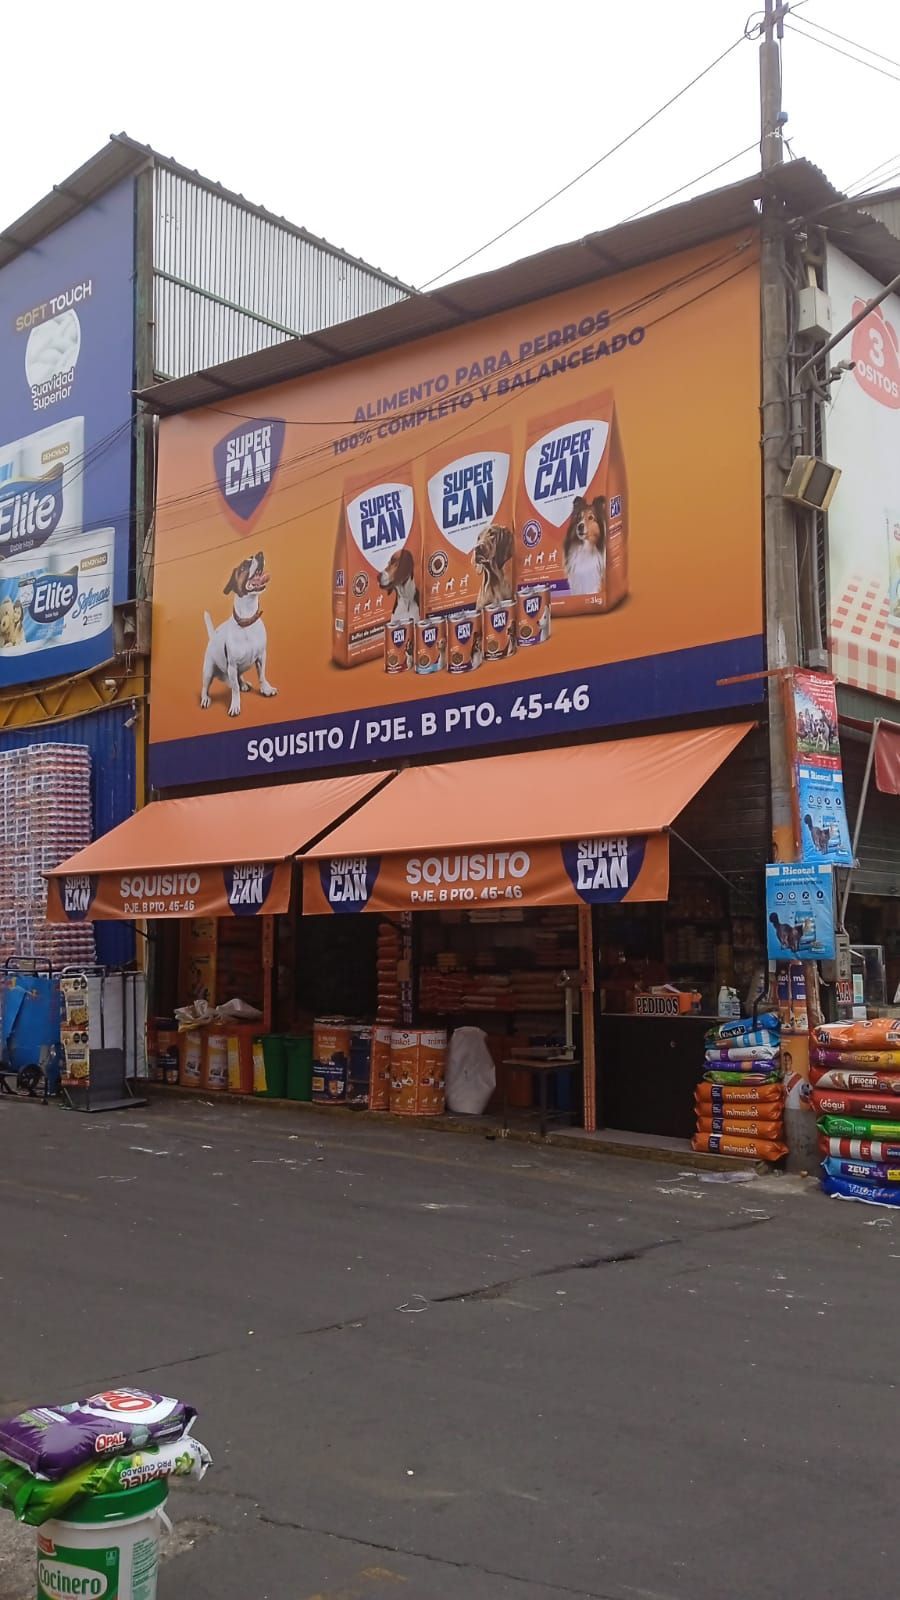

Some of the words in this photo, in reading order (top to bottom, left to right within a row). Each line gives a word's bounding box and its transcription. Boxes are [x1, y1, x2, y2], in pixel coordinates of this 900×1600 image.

[16, 303, 47, 332] SOFT
[49, 280, 92, 314] TOUCH
[869, 328, 885, 368] 3
[354, 374, 449, 423] ALIMENTO
[455, 350, 513, 386] PARA
[519, 310, 611, 361] PERROS
[857, 359, 899, 398] OSITOS
[31, 368, 74, 399] Suavidad
[332, 424, 373, 456] 100%
[377, 391, 475, 440] COMPLETO
[480, 385, 491, 403] Y
[496, 326, 646, 398] BALANCEADO
[33, 386, 72, 411] Superior
[226, 426, 271, 462] SUPER
[538, 428, 592, 466] SUPER
[225, 447, 271, 496] CAN
[443, 459, 493, 495] SUPER
[533, 450, 590, 500] CAN
[0, 491, 56, 543] Elite
[359, 490, 401, 520] SUPER
[442, 481, 494, 529] CAN
[361, 509, 406, 551] CAN
[33, 582, 74, 613] Elite
[247, 726, 344, 763] SQUISITO
[349, 720, 361, 749] /
[366, 717, 413, 744] PJE.
[421, 712, 437, 736] B
[445, 702, 502, 732] PTO.
[510, 685, 590, 721] 45-46
[577, 839, 628, 859] SUPER
[233, 863, 264, 880] SUPER
[330, 858, 367, 875] SUPER
[406, 851, 530, 886] SQUISITO
[577, 855, 629, 890] CAN
[65, 876, 90, 890] SUPER
[119, 872, 200, 899] SQUISITO
[229, 878, 264, 904] CAN
[329, 874, 368, 902] CAN
[411, 890, 437, 902] PJE.
[439, 889, 447, 901] B
[450, 887, 477, 901] PTO.
[480, 885, 522, 899] 45-46
[64, 888, 91, 912] CAN
[124, 902, 142, 913] PJE.
[143, 901, 148, 912] B
[149, 901, 167, 912] PTO.
[169, 899, 195, 912] 45-46
[637, 997, 679, 1016] PEDIDOS
[725, 1090, 759, 1099] mimaskot
[725, 1108, 758, 1117] mimaskot
[726, 1125, 758, 1135] mimaskot
[723, 1143, 757, 1154] mimaskot
[848, 1165, 870, 1175] ZEUS
[95, 1432, 126, 1452] OPAL
[121, 1464, 155, 1478] CUIDADO
[157, 1459, 172, 1468] PRO
[40, 1562, 101, 1595] Cocinero
